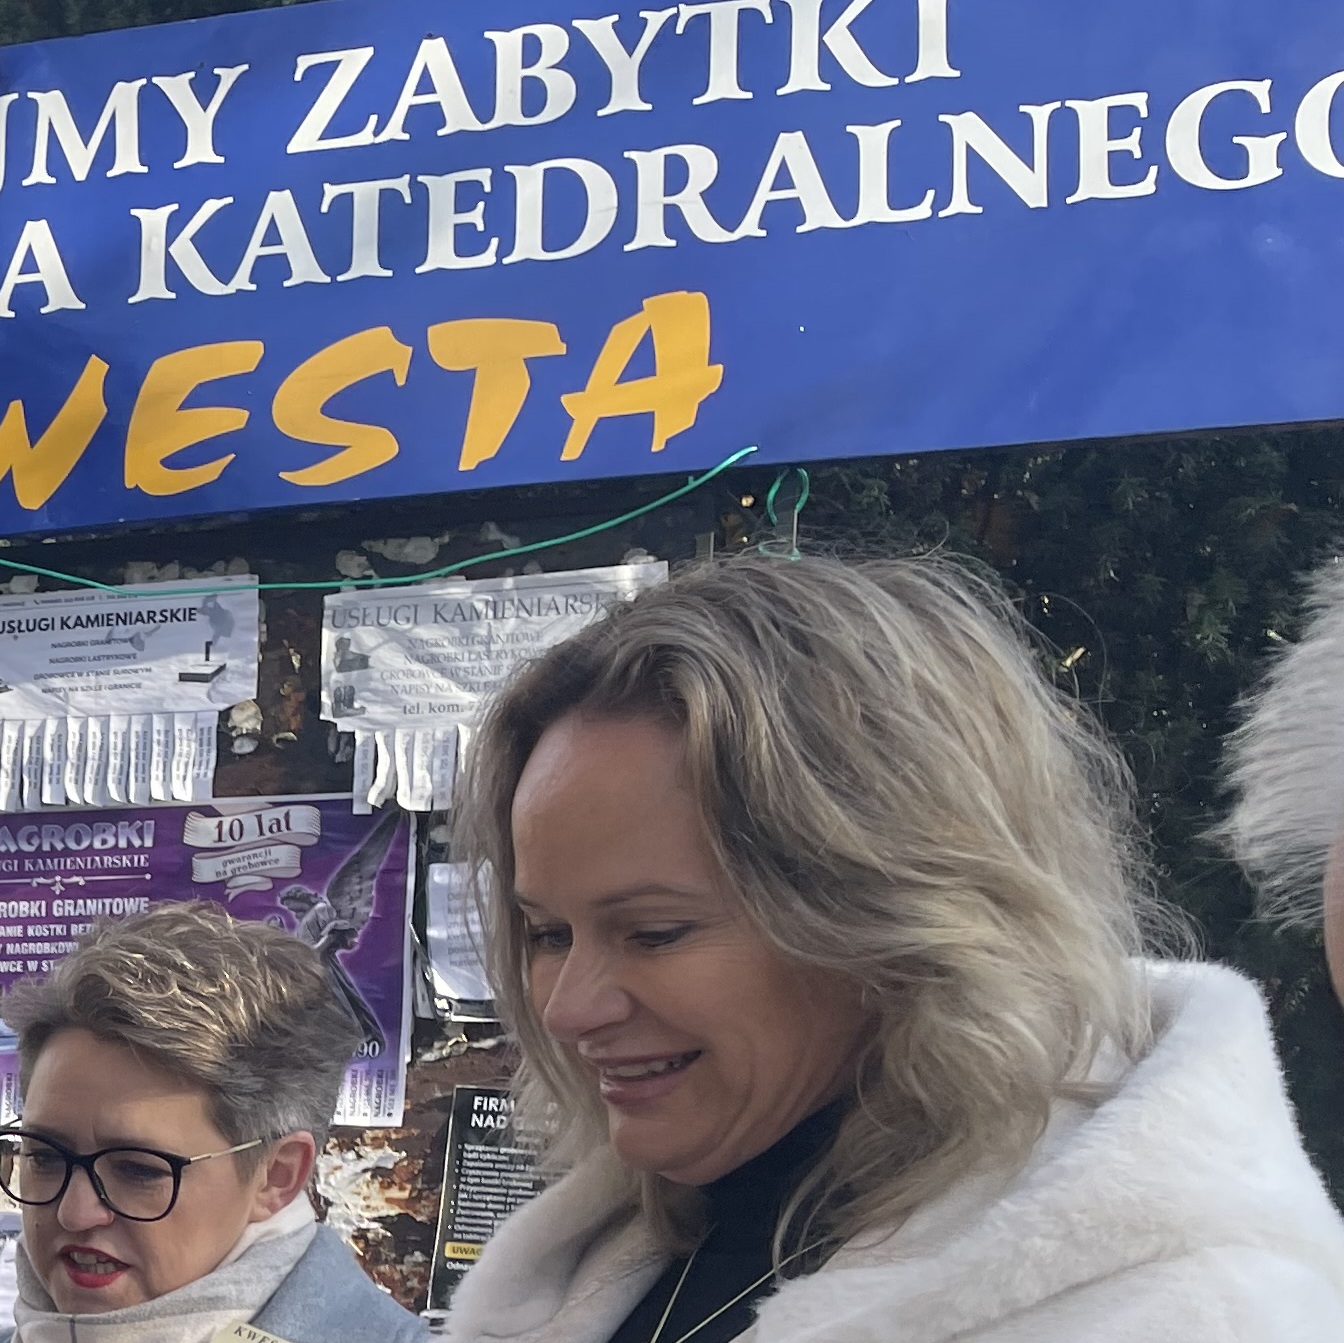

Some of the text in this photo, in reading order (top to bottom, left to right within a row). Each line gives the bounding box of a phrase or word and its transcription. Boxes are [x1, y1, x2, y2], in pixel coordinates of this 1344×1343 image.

[285, 0, 961, 155] ZABYTKI
[60, 607, 197, 631] KAMIENIARSKIE
[331, 604, 419, 629] USŁUGI
[403, 703, 424, 715] tel.
[429, 702, 464, 714] kom.
[213, 809, 292, 844] 10 lat
[23, 853, 150, 872] KAMIENIARSKIE
[221, 848, 273, 868] gwarancji
[230, 856, 281, 877] grobowce
[52, 896, 149, 917] GRANITOWE
[27, 923, 67, 937] KOSTKI
[27, 961, 38, 972] W
[352, 1040, 380, 1058] 90
